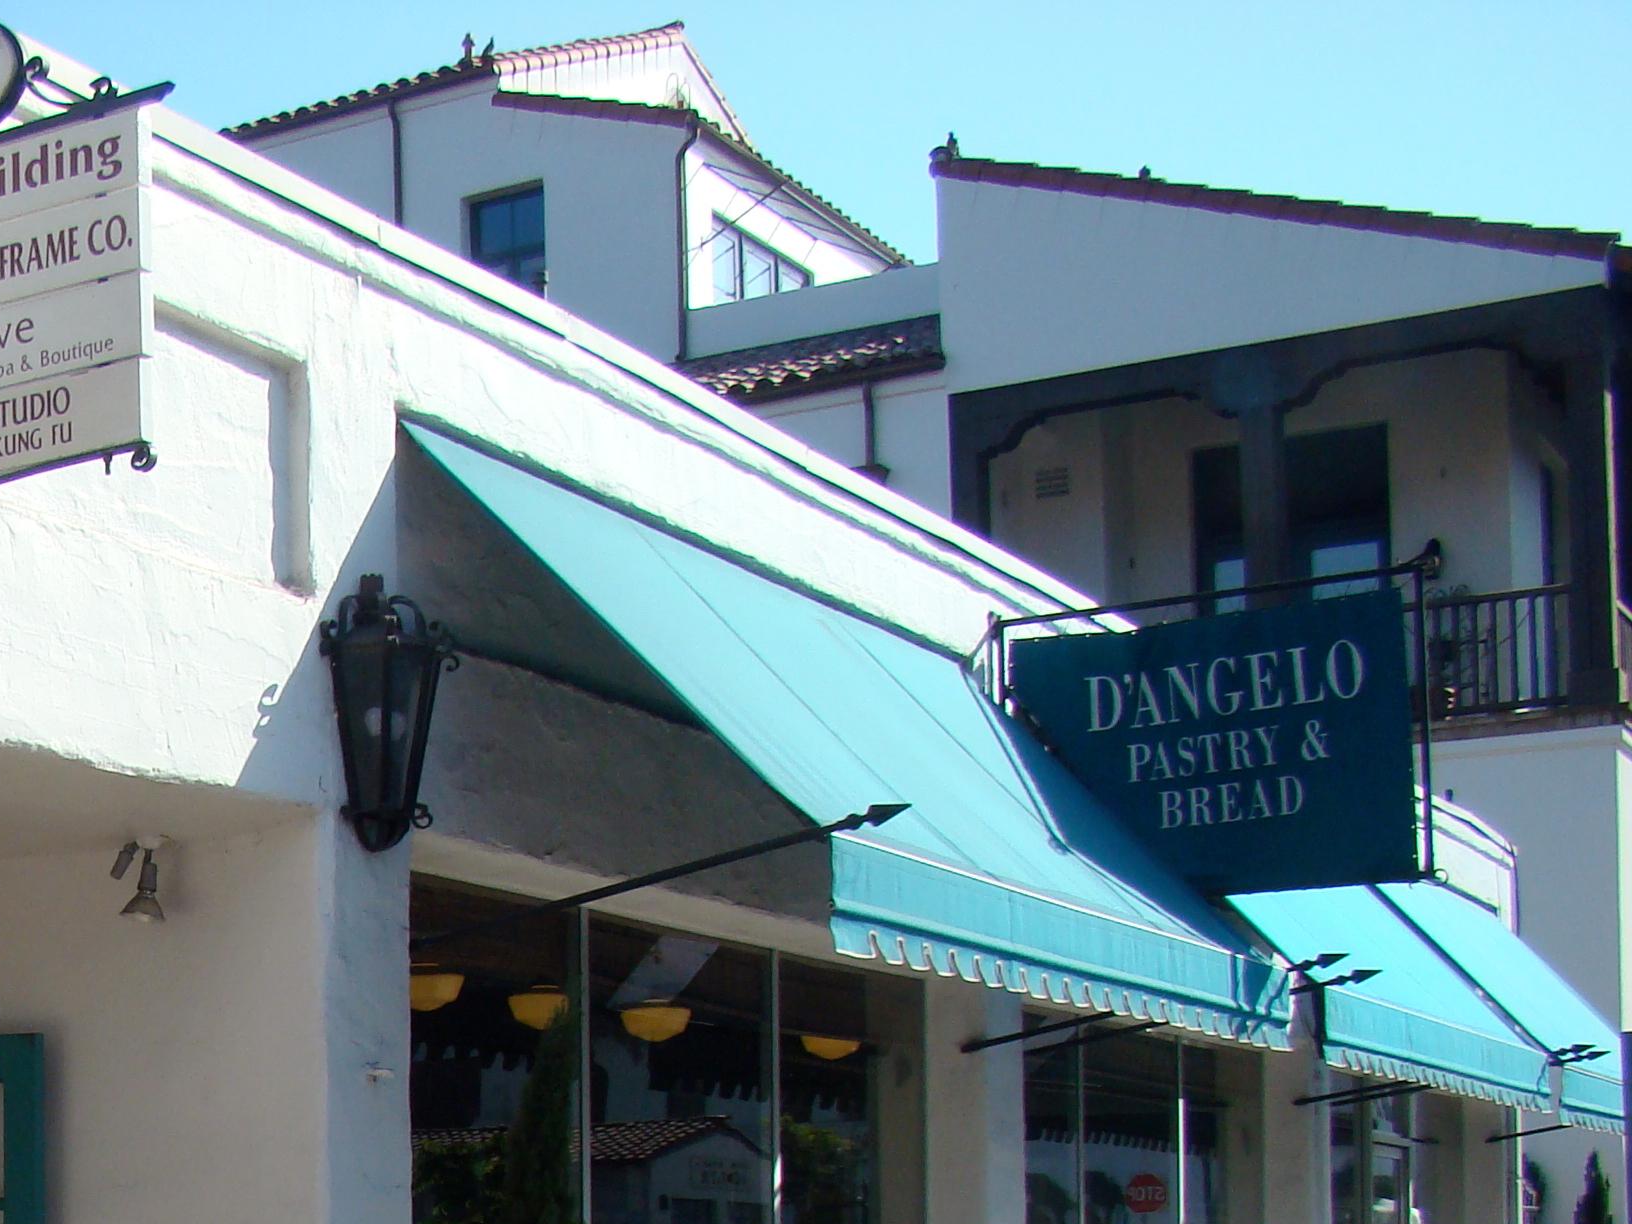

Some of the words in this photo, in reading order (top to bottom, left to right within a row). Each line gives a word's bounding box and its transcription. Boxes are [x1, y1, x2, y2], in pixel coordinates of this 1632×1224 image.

[0, 226, 80, 280] FRAME
[87, 214, 132, 256] CO.
[20, 354, 33, 371] &
[40, 336, 114, 368] Boutique
[1083, 638, 1365, 733] D'ANGELO
[1126, 724, 1279, 784] PASTRY
[1300, 719, 1331, 761] &
[1158, 775, 1305, 830] BREAD
